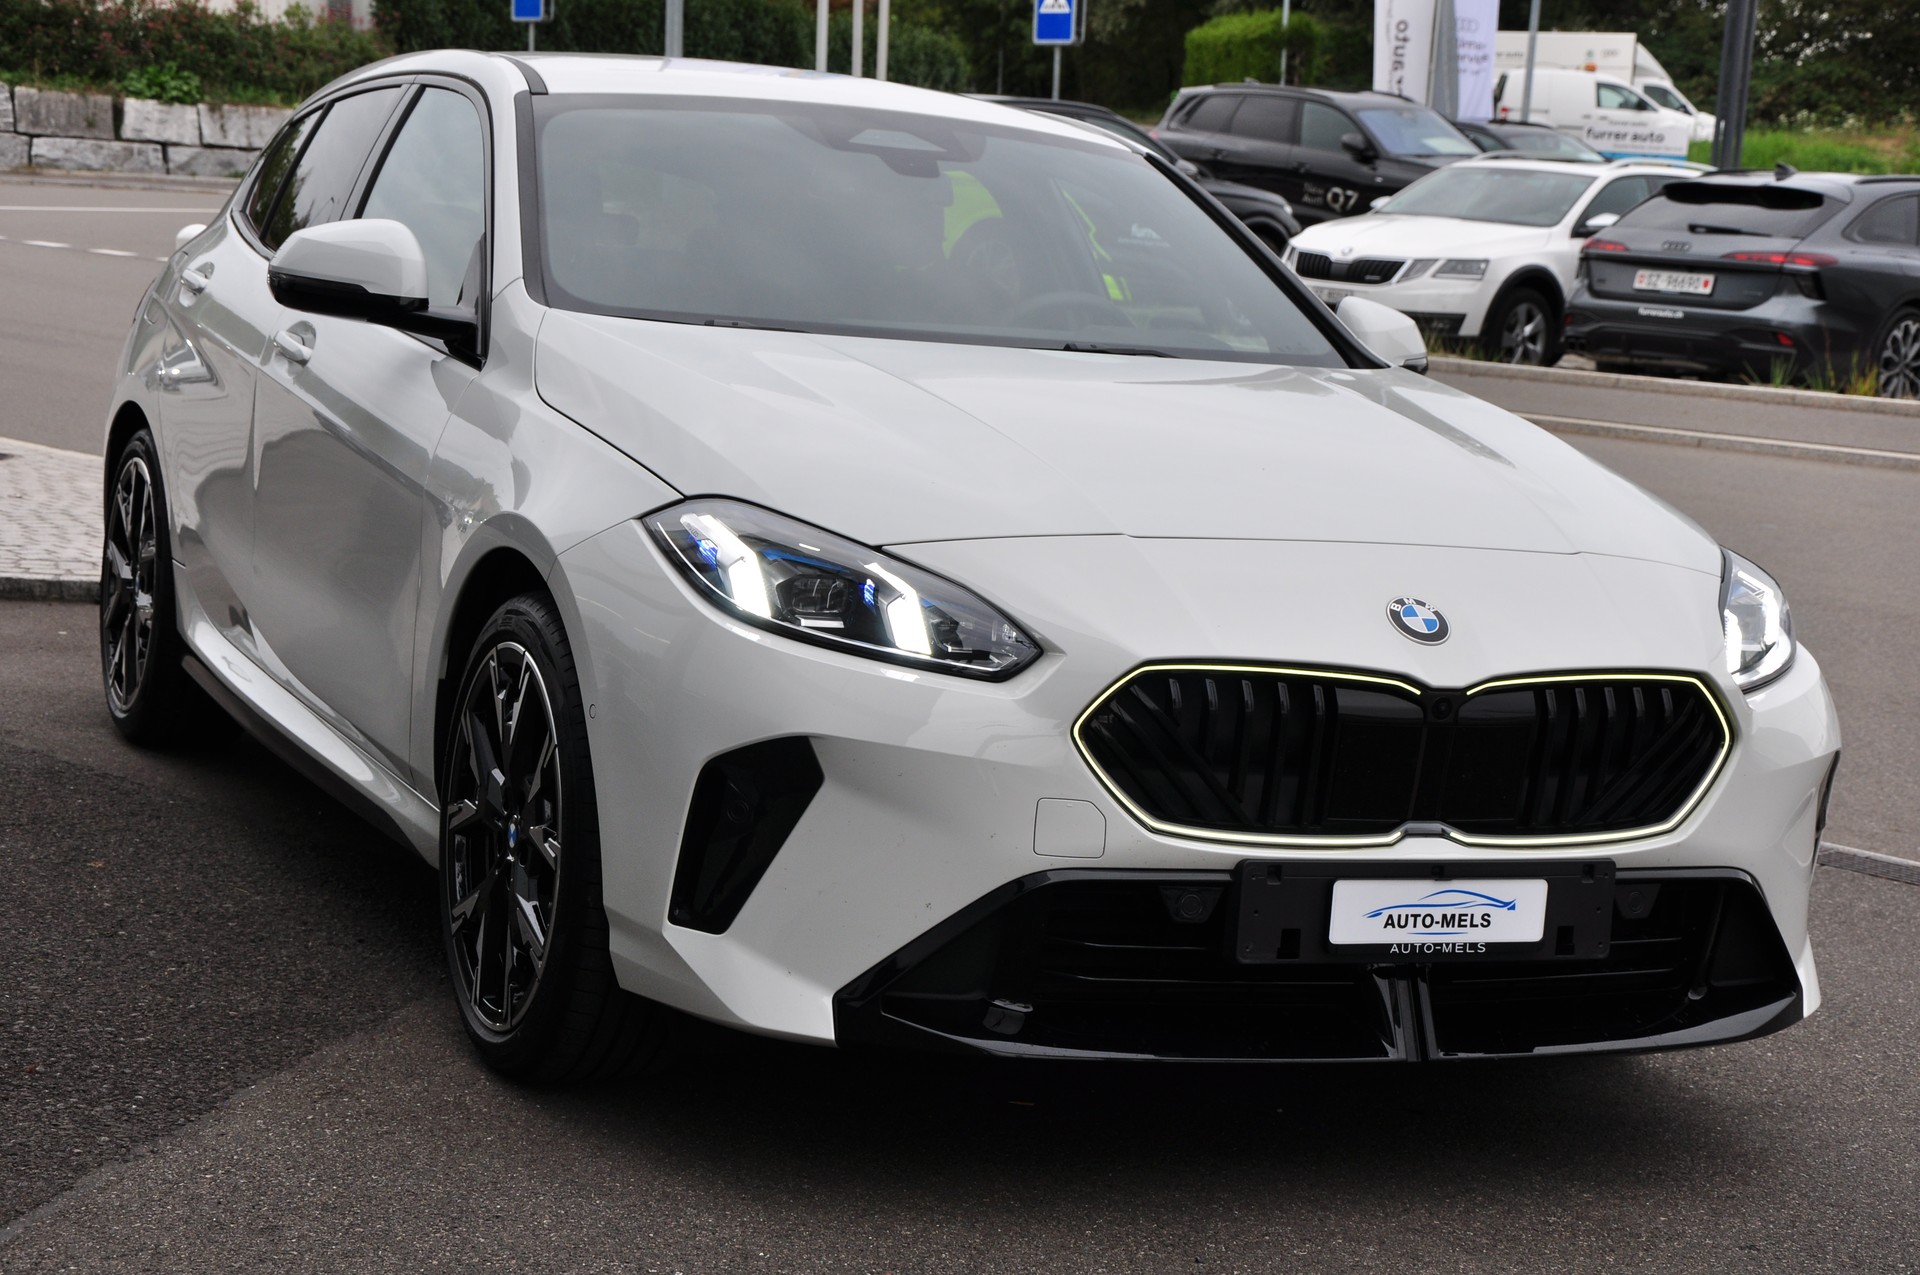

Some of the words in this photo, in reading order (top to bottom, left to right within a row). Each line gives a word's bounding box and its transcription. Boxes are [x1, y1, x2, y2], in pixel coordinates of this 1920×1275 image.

[1586, 127, 1628, 140] furrer
[1631, 131, 1665, 143] auto
[1326, 186, 1359, 212] Q7
[1390, 598, 1438, 612] BMW
[1383, 912, 1492, 929] AUTO-MELS
[1389, 942, 1486, 954] AUTO-MELS
